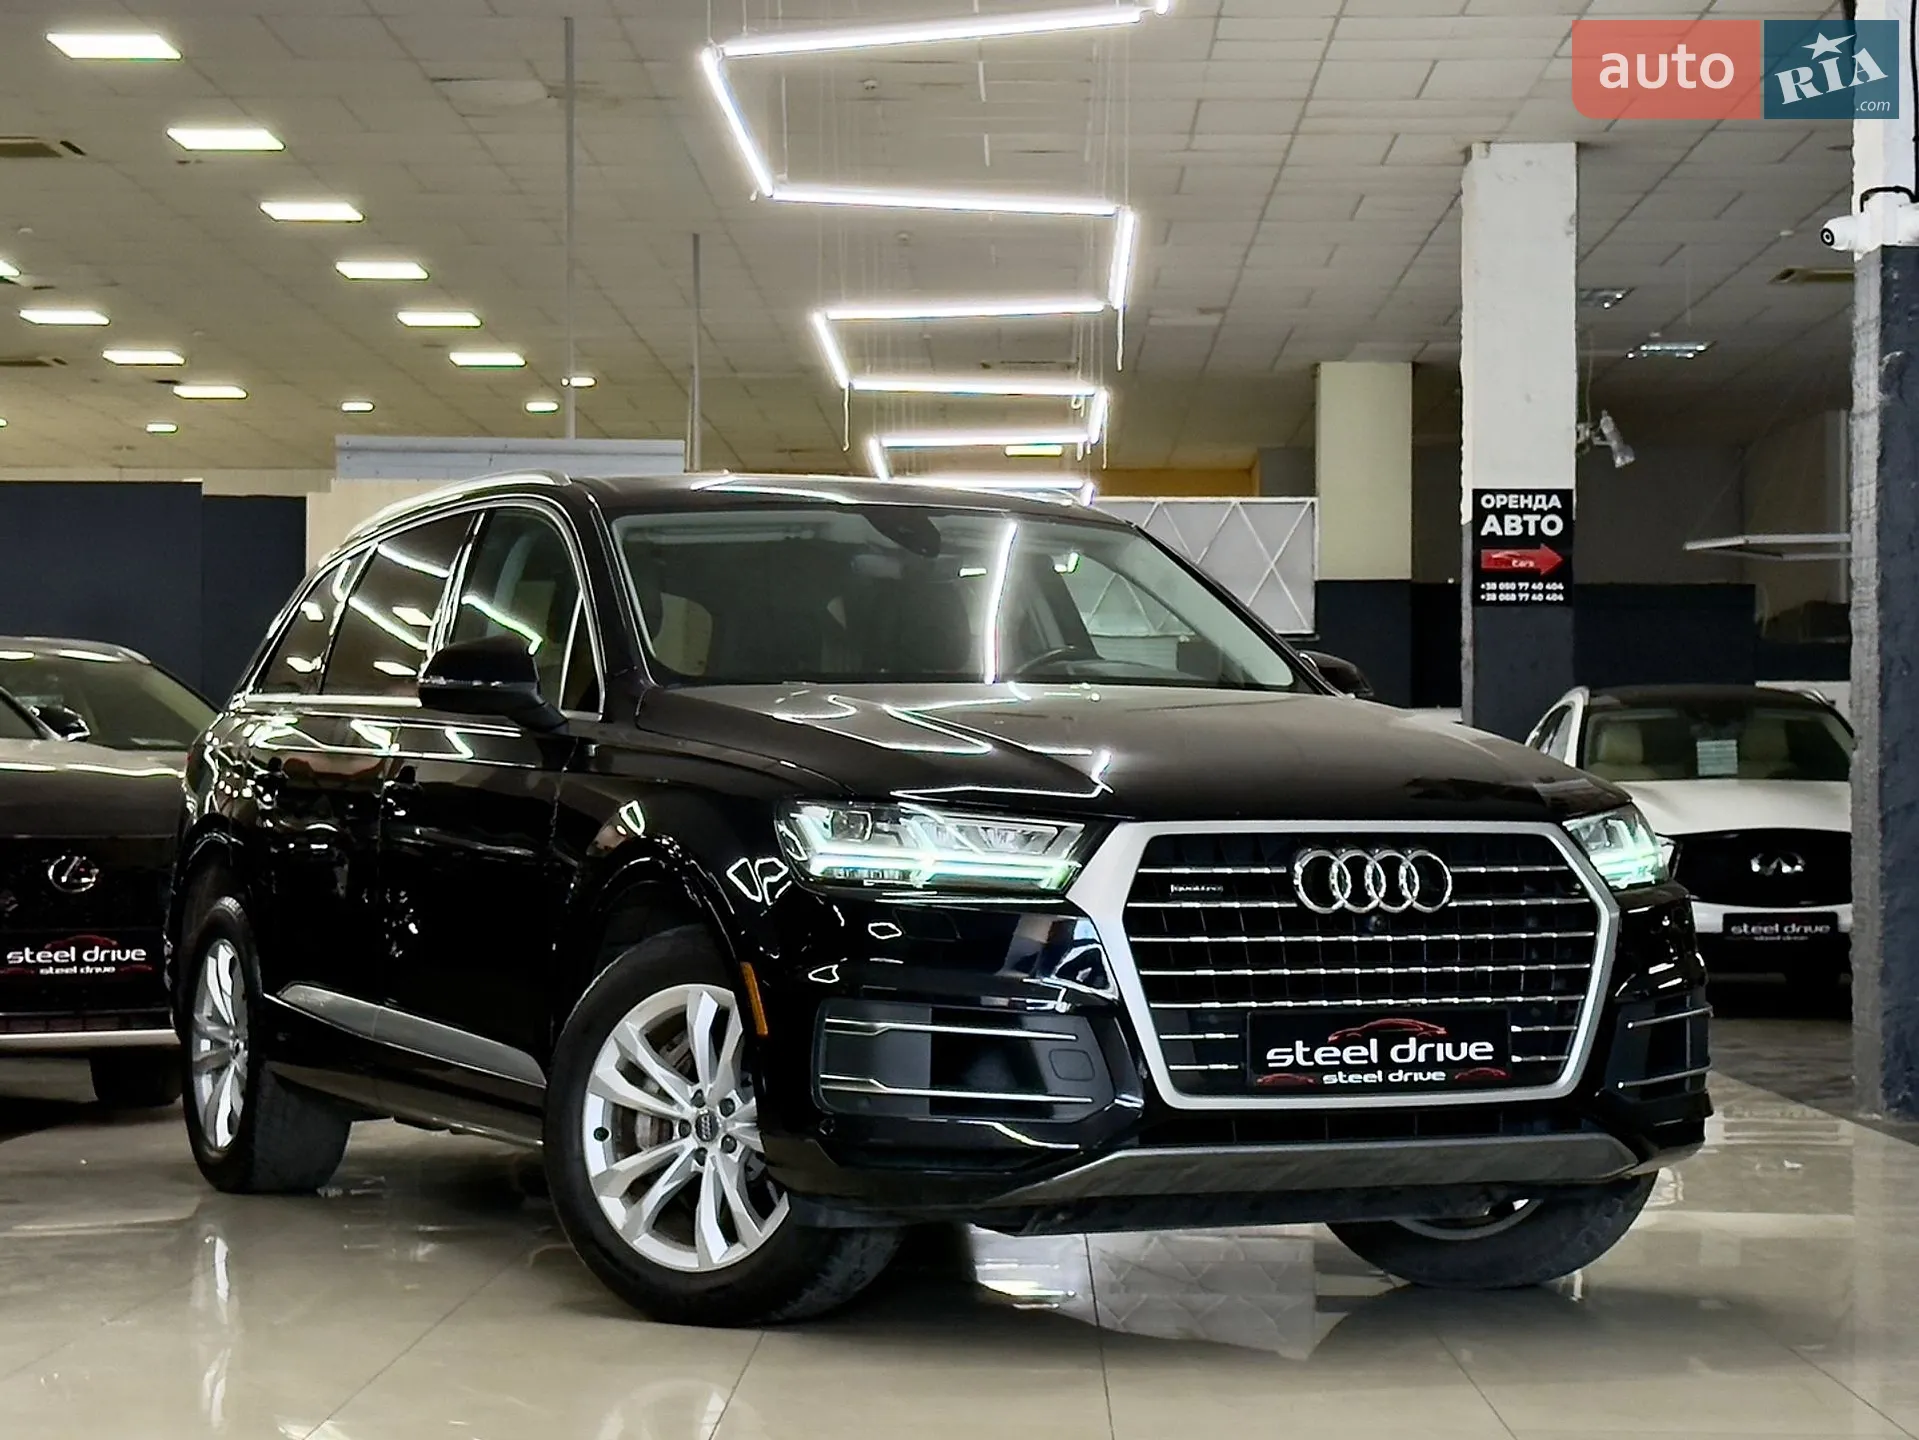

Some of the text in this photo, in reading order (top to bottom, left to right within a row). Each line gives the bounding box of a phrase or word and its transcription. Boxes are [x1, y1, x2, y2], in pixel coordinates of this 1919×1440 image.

[1480, 494, 1562, 511] ОРЕНДА
[1480, 514, 1564, 536] АВТО
[1518, 582, 1530, 590] 77
[1531, 582, 1544, 590] 40
[1545, 582, 1564, 590] 404
[1518, 593, 1530, 601] 77
[1531, 593, 1544, 601] 40
[1545, 593, 1564, 601] 404
[1731, 923, 1779, 935] steel
[6, 945, 147, 964] steel drive
[1266, 1036, 1494, 1068] steel drive
[1322, 1069, 1446, 1084] steel drive
